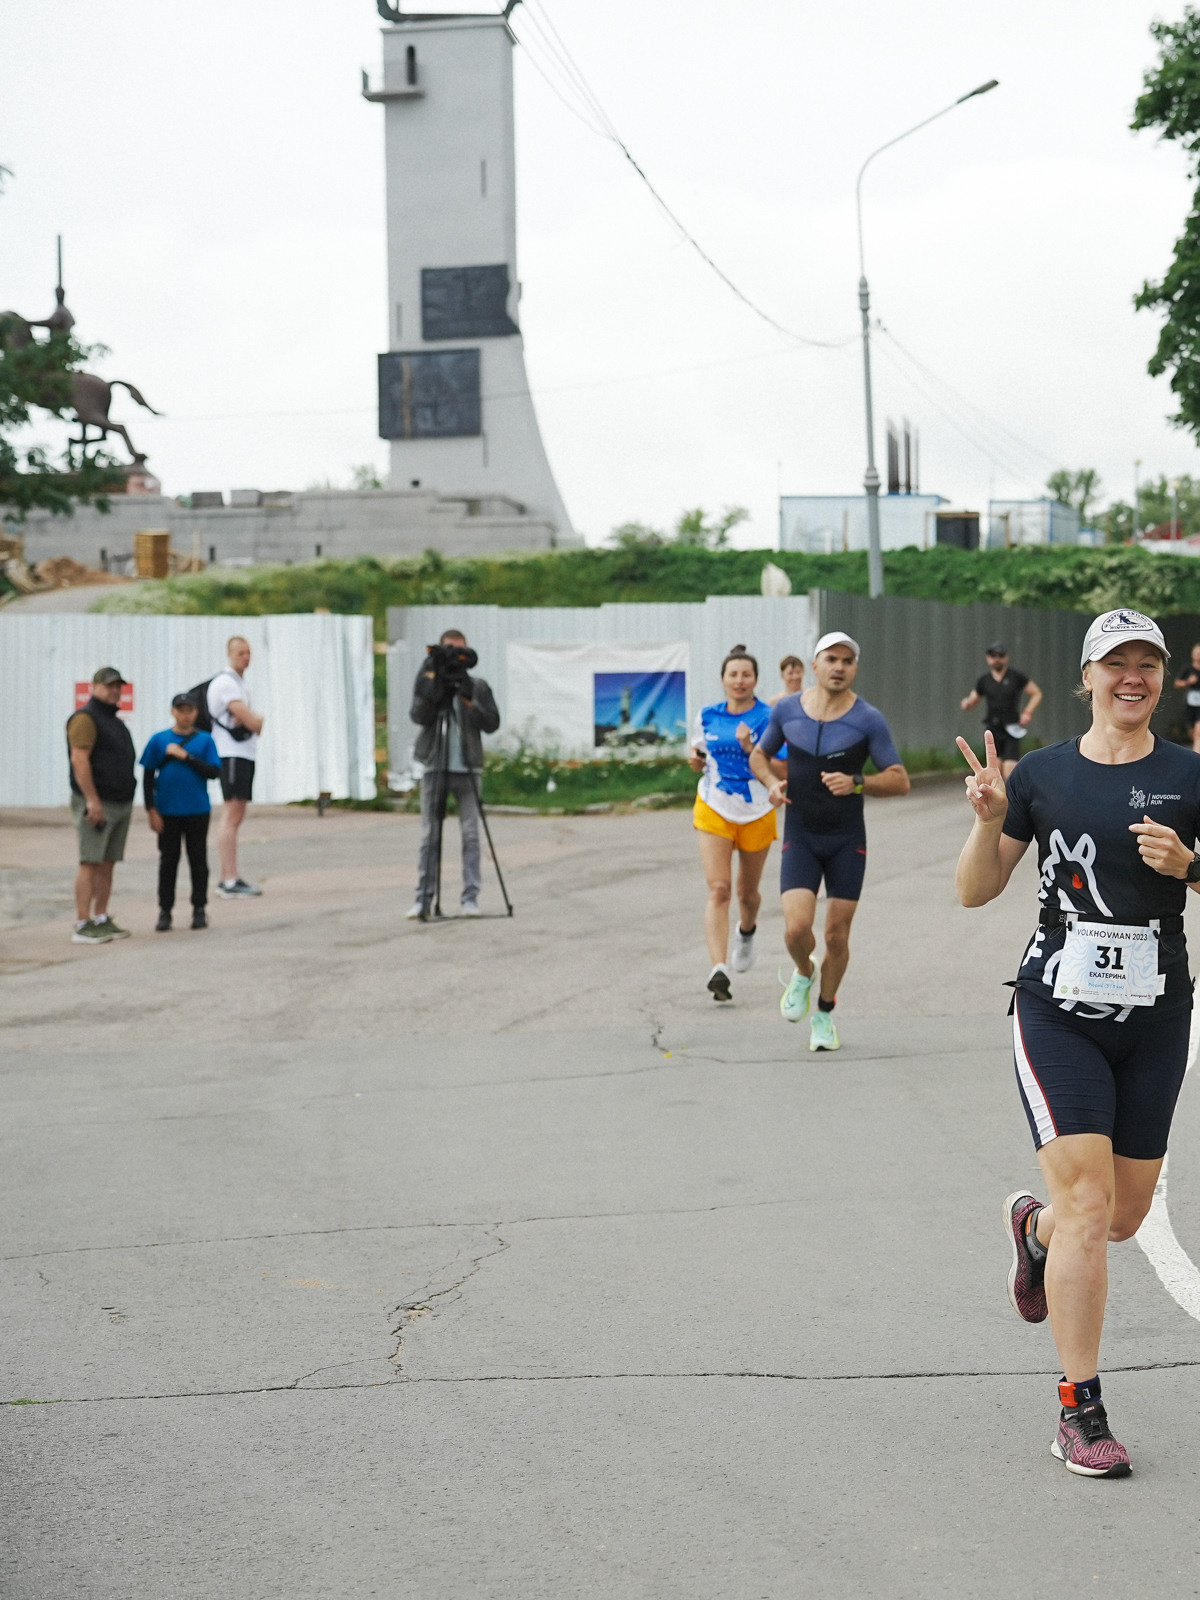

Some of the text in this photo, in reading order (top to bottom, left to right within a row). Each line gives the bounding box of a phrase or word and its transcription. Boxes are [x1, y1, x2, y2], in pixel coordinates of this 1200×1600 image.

[1077, 928, 1148, 941] VOLKHOVMAN 2023
[1094, 945, 1124, 970] 31
[1089, 971, 1126, 980] ЕКАТЕРИНА
